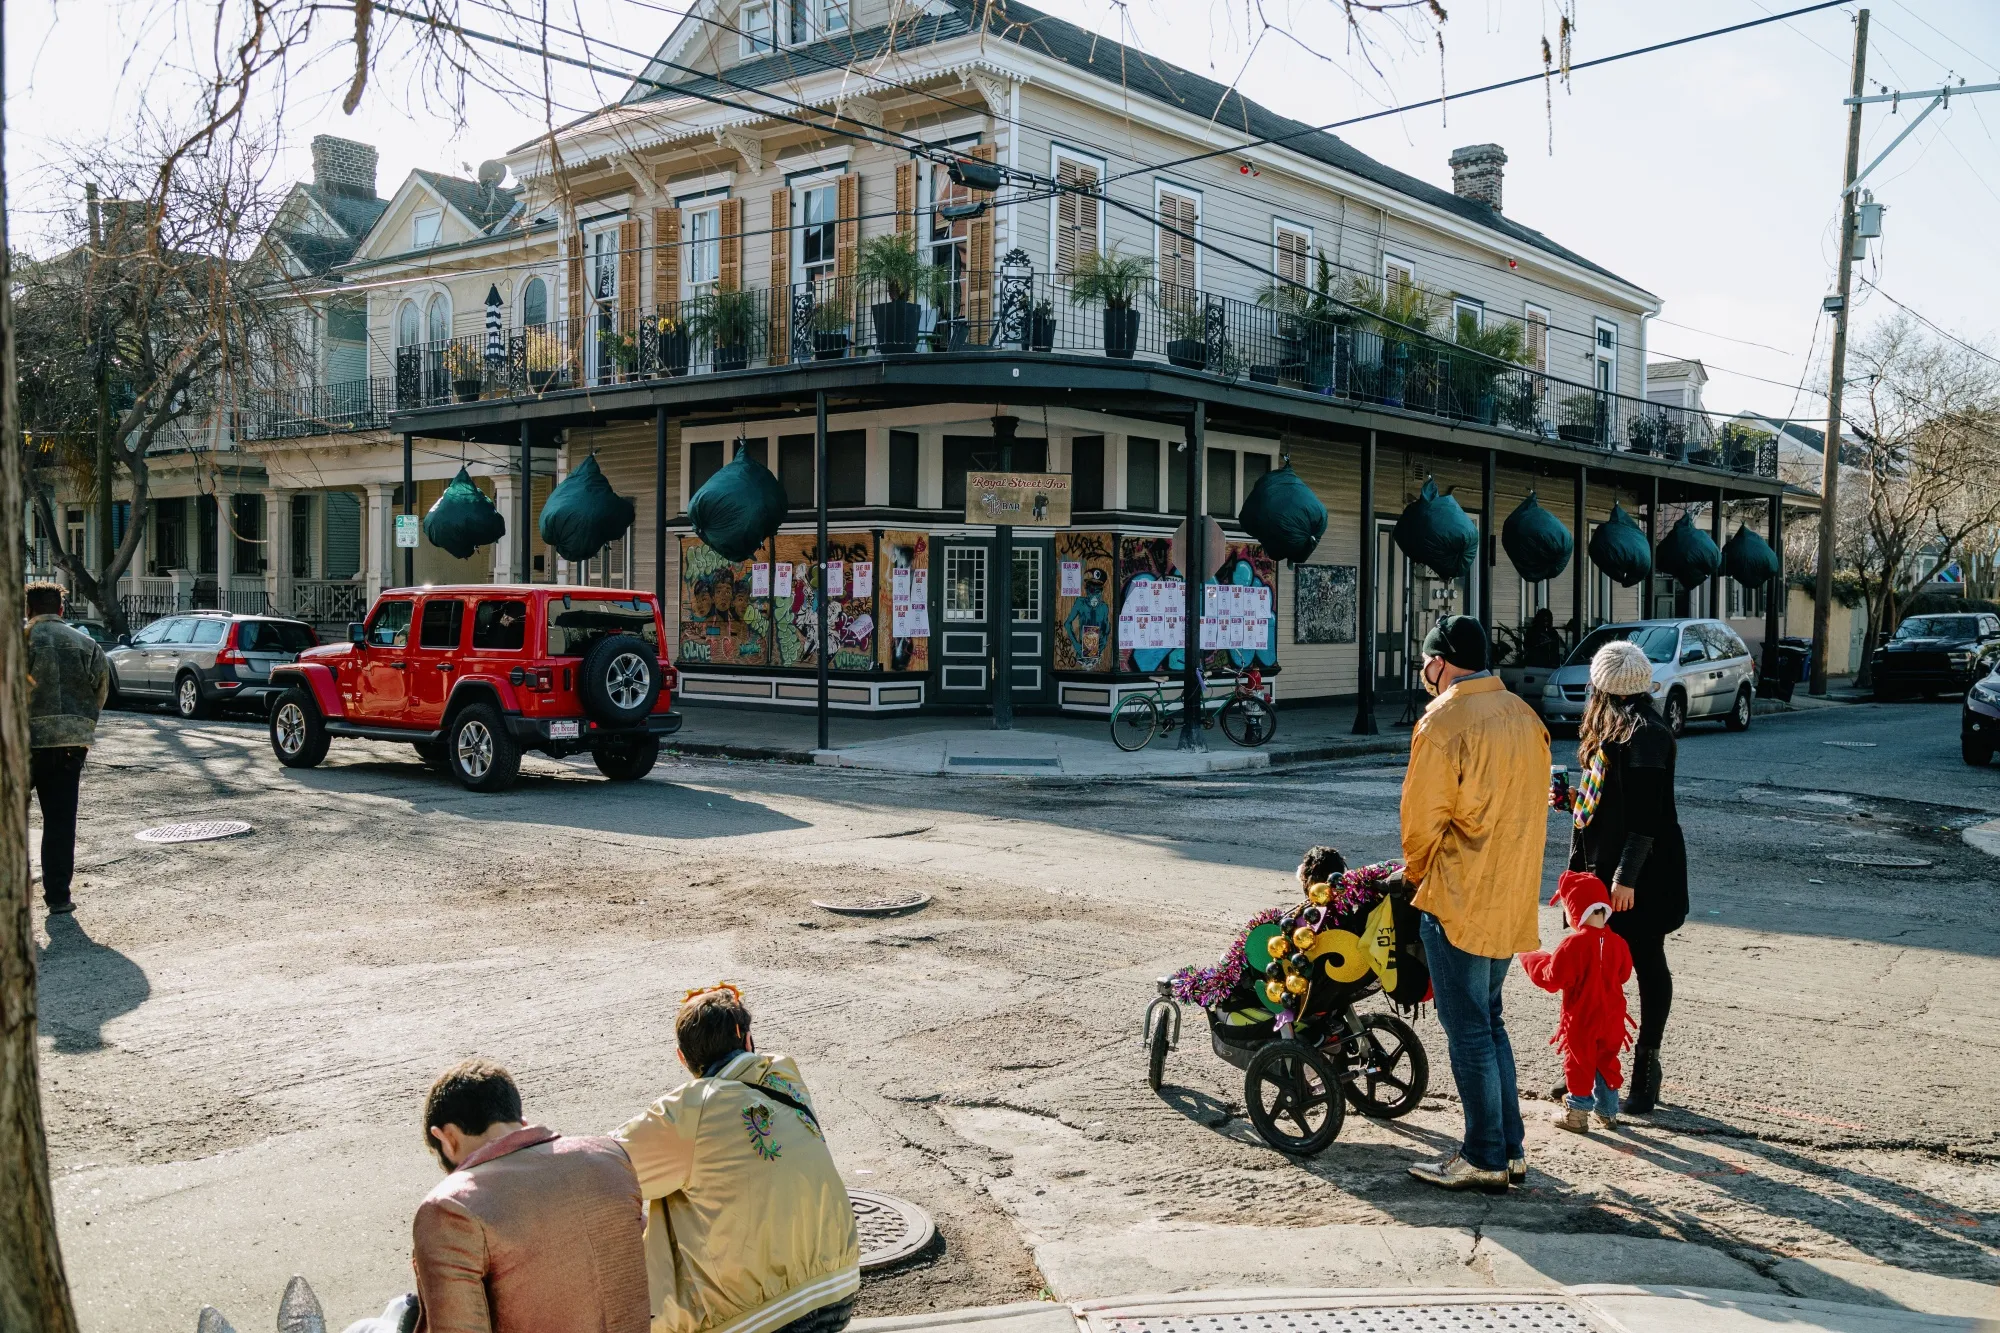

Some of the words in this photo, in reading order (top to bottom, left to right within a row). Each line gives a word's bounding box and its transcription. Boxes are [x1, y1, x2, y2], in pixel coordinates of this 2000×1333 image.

[972, 476, 1006, 489] Royal
[1008, 477, 1041, 488] Street
[1044, 478, 1066, 489] Inn
[1002, 502, 1020, 511] BAR
[398, 518, 403, 526] 2
[683, 641, 711, 661] OLIVE
